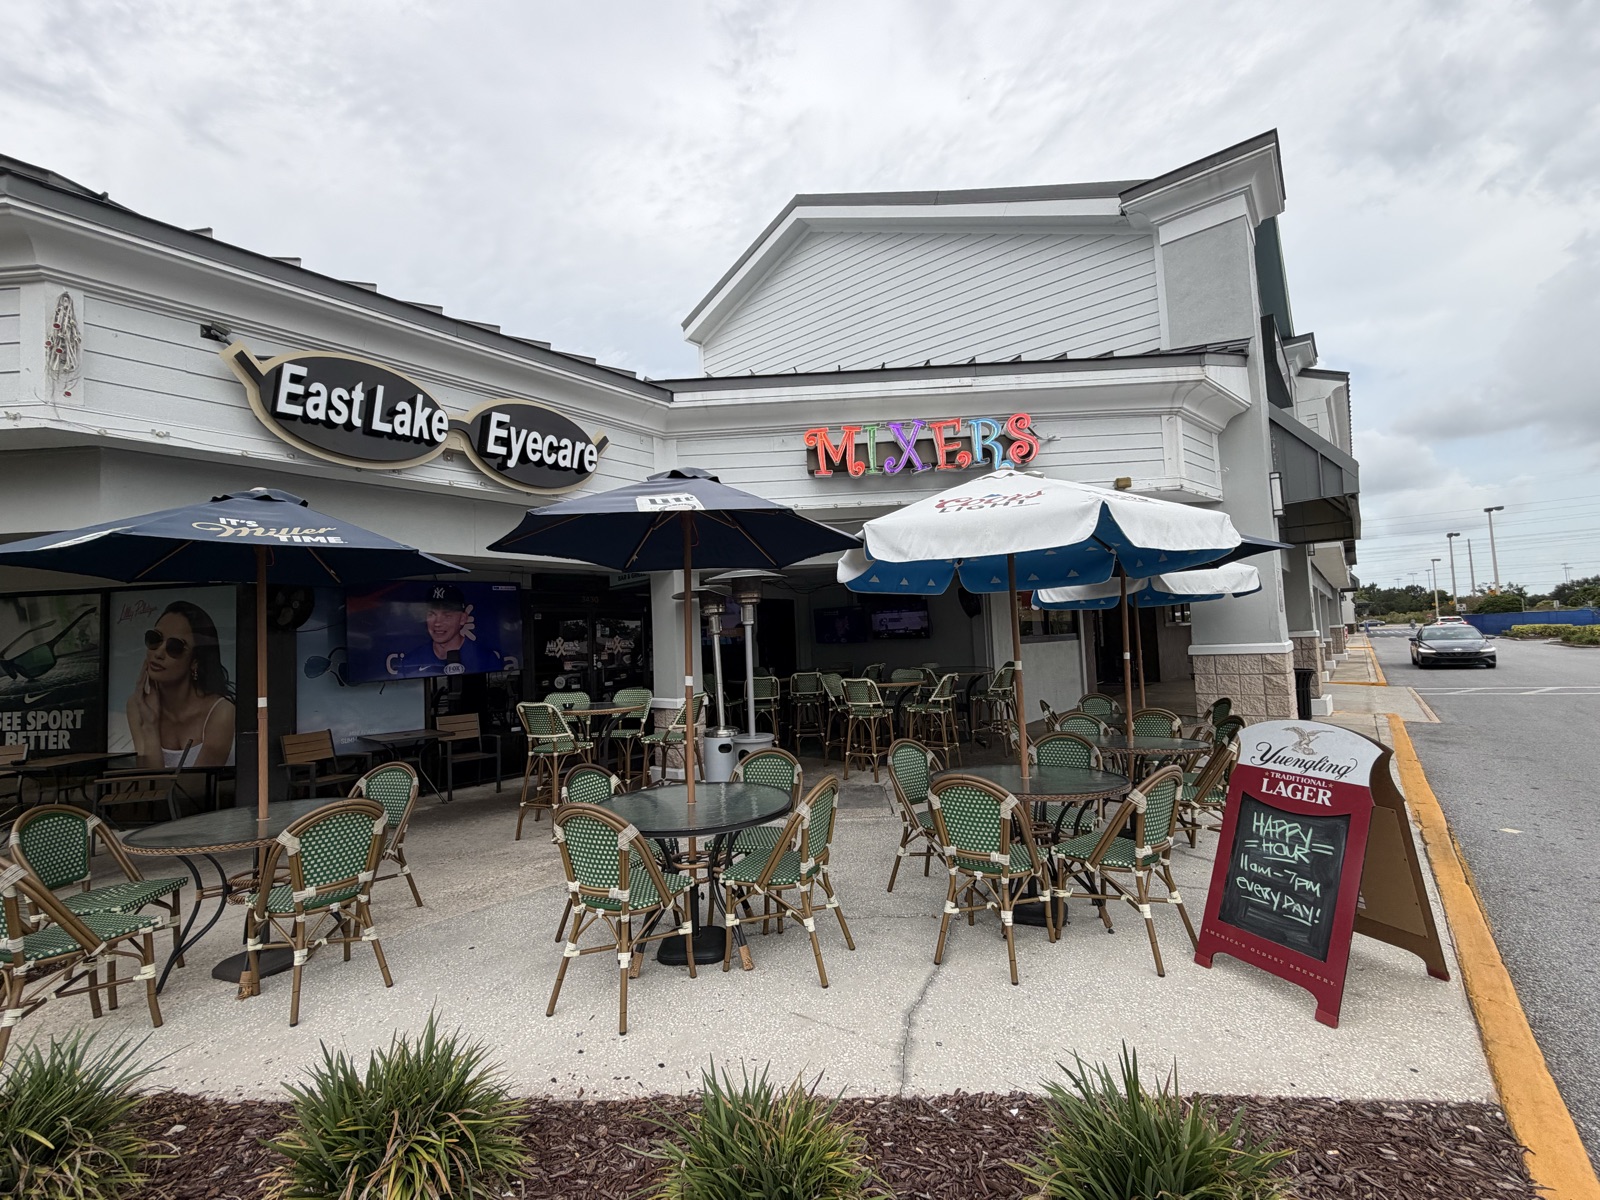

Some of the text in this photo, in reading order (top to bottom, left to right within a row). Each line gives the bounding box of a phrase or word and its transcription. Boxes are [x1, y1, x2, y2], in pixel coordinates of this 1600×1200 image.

[275, 362, 598, 474] East Lake Eyecare
[803, 412, 1040, 477] MIXERS
[934, 490, 1043, 509] Coors
[938, 499, 1025, 514] LIGHT
[191, 521, 337, 538] Miller
[218, 517, 259, 528] IT'S
[0, 709, 85, 732] EE SPORT
[4, 730, 71, 750] BETTER
[1250, 741, 1358, 780] Yuengling
[1270, 771, 1328, 788] TRADITIONAL
[1260, 777, 1332, 807] LAGER
[1252, 812, 1313, 850] HAPPY
[1262, 839, 1311, 864] HOUR
[1204, 928, 1246, 949] AMERICA'S
[1250, 947, 1285, 965] OLDEST
